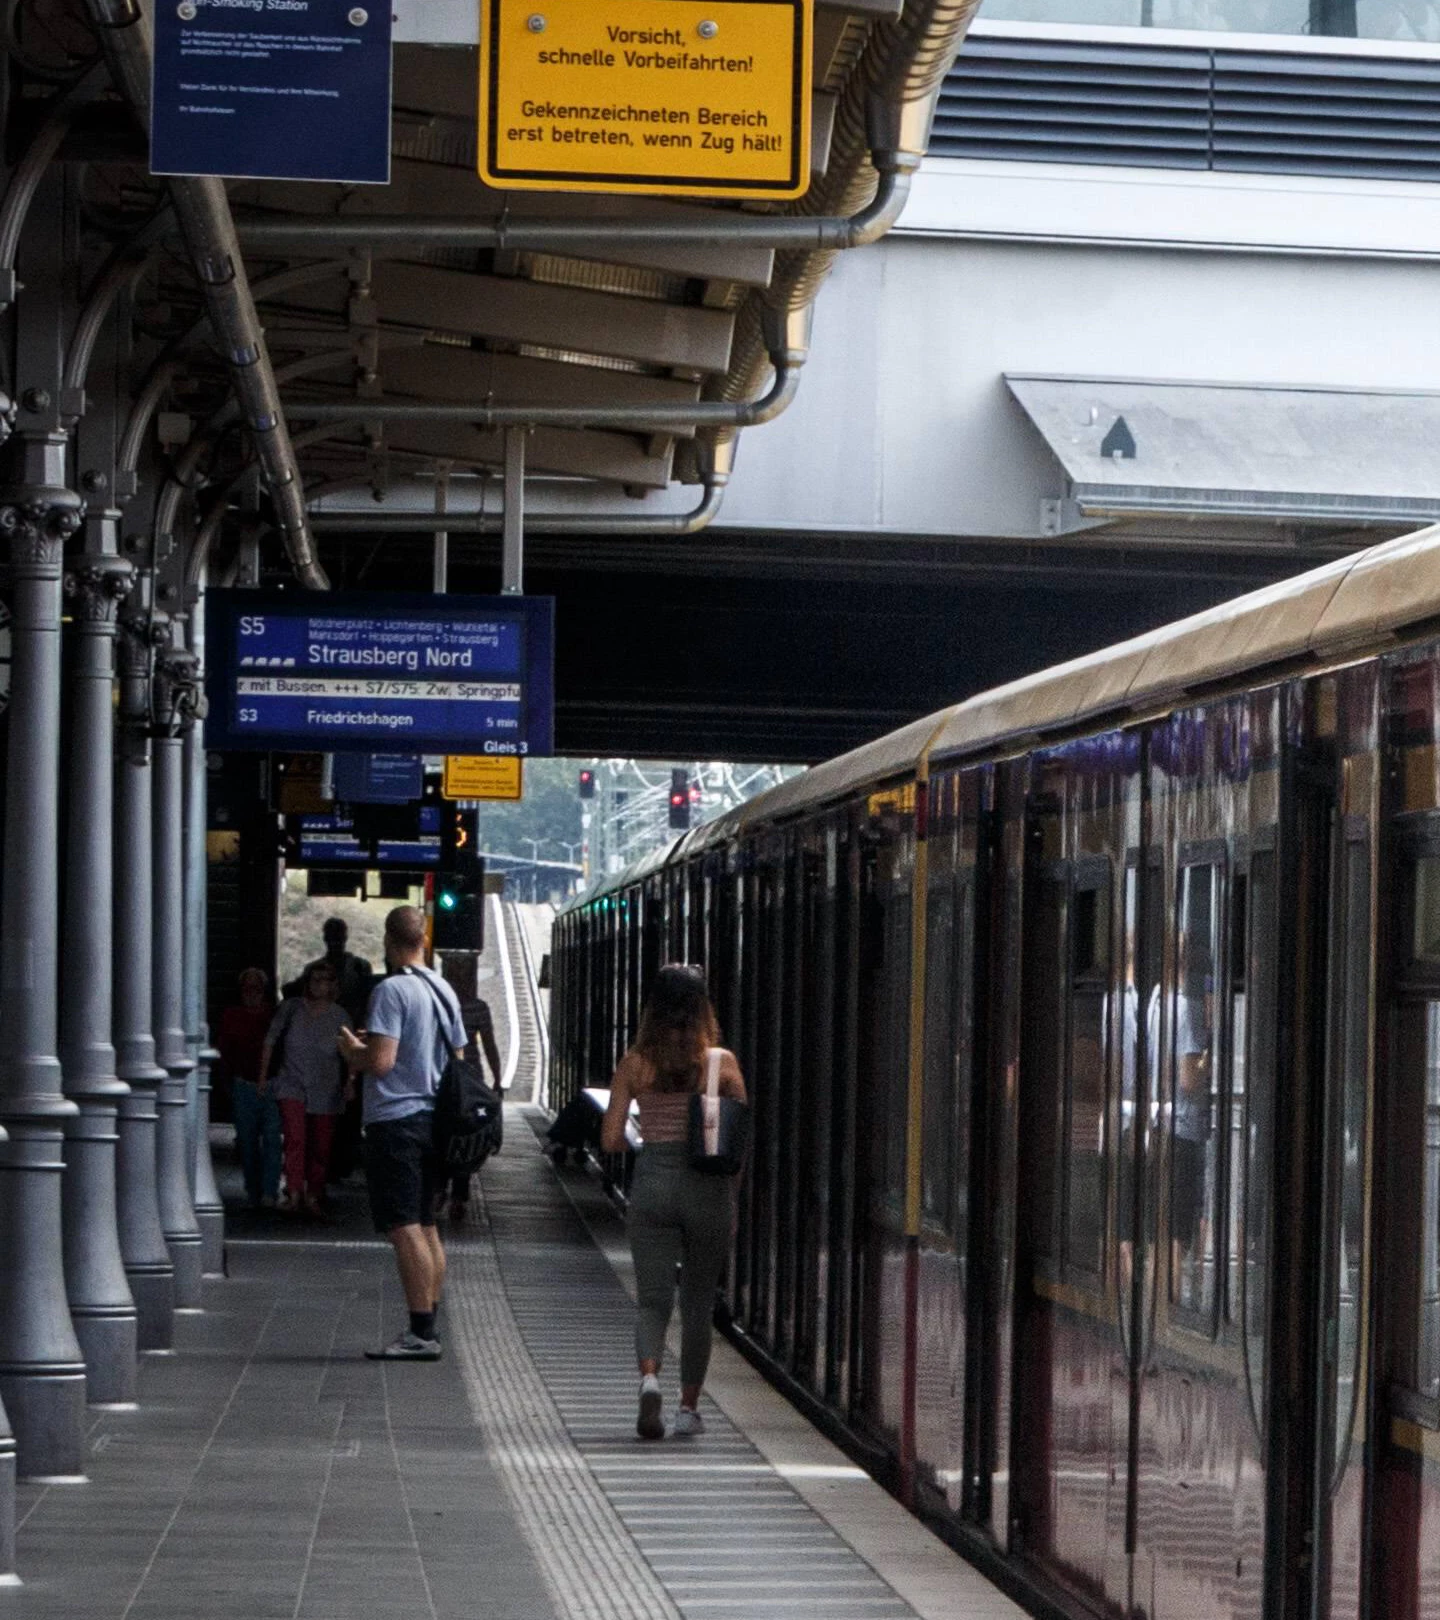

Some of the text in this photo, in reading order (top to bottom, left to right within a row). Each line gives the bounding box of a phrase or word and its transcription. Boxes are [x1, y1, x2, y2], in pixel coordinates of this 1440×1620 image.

[267, 0, 308, 11] Station
[606, 26, 686, 48] Vorsicht,
[537, 48, 753, 73] schnelle Vorbeifahrten!
[522, 100, 768, 127] Gekennzeichneten Bereich
[507, 126, 782, 154] erst betreten, wenn Zug hält!
[240, 617, 265, 635] S5
[443, 634, 499, 648] Strausberg
[308, 644, 472, 670] Strausberg Nord
[250, 680, 273, 692] mit
[239, 709, 518, 728] S3 Friedrichshagen 5 min
[484, 741, 528, 753] Gleis 3
